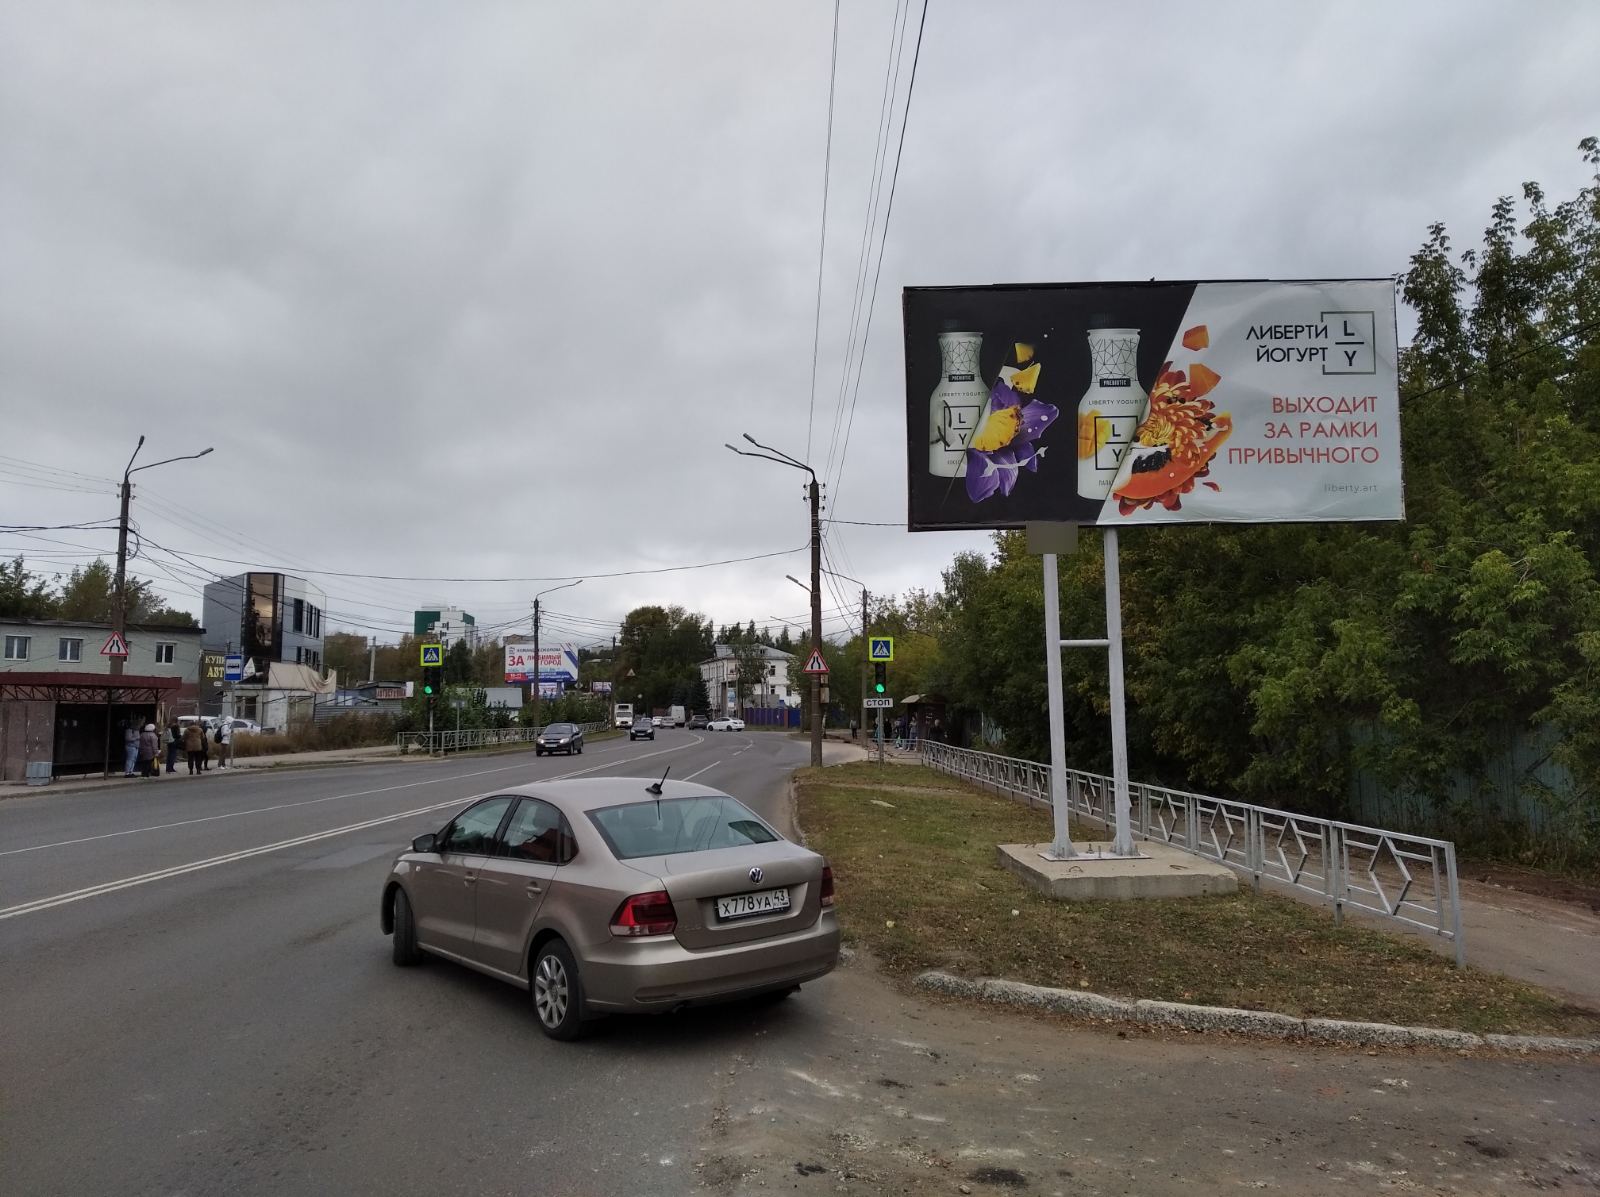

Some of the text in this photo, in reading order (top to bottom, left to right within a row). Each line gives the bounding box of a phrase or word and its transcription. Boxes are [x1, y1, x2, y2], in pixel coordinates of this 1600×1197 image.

[1246, 324, 1329, 341] ЛИБЕРТИ
[1343, 320, 1355, 336] L
[1256, 345, 1329, 362] ЙОГУРТ
[1343, 350, 1357, 367] Y
[1272, 397, 1378, 414] ВЫХОДИТ
[958, 412, 966, 423] L
[1112, 424, 1121, 437] L
[1264, 421, 1378, 438] ЗА РАМКИ
[1228, 446, 1380, 464] ПРИВЫЧНОГО
[1323, 483, 1378, 494] liberty.art
[508, 655, 525, 666] ЗА
[207, 667, 225, 678] АВТ
[773, 890, 785, 902] 43
